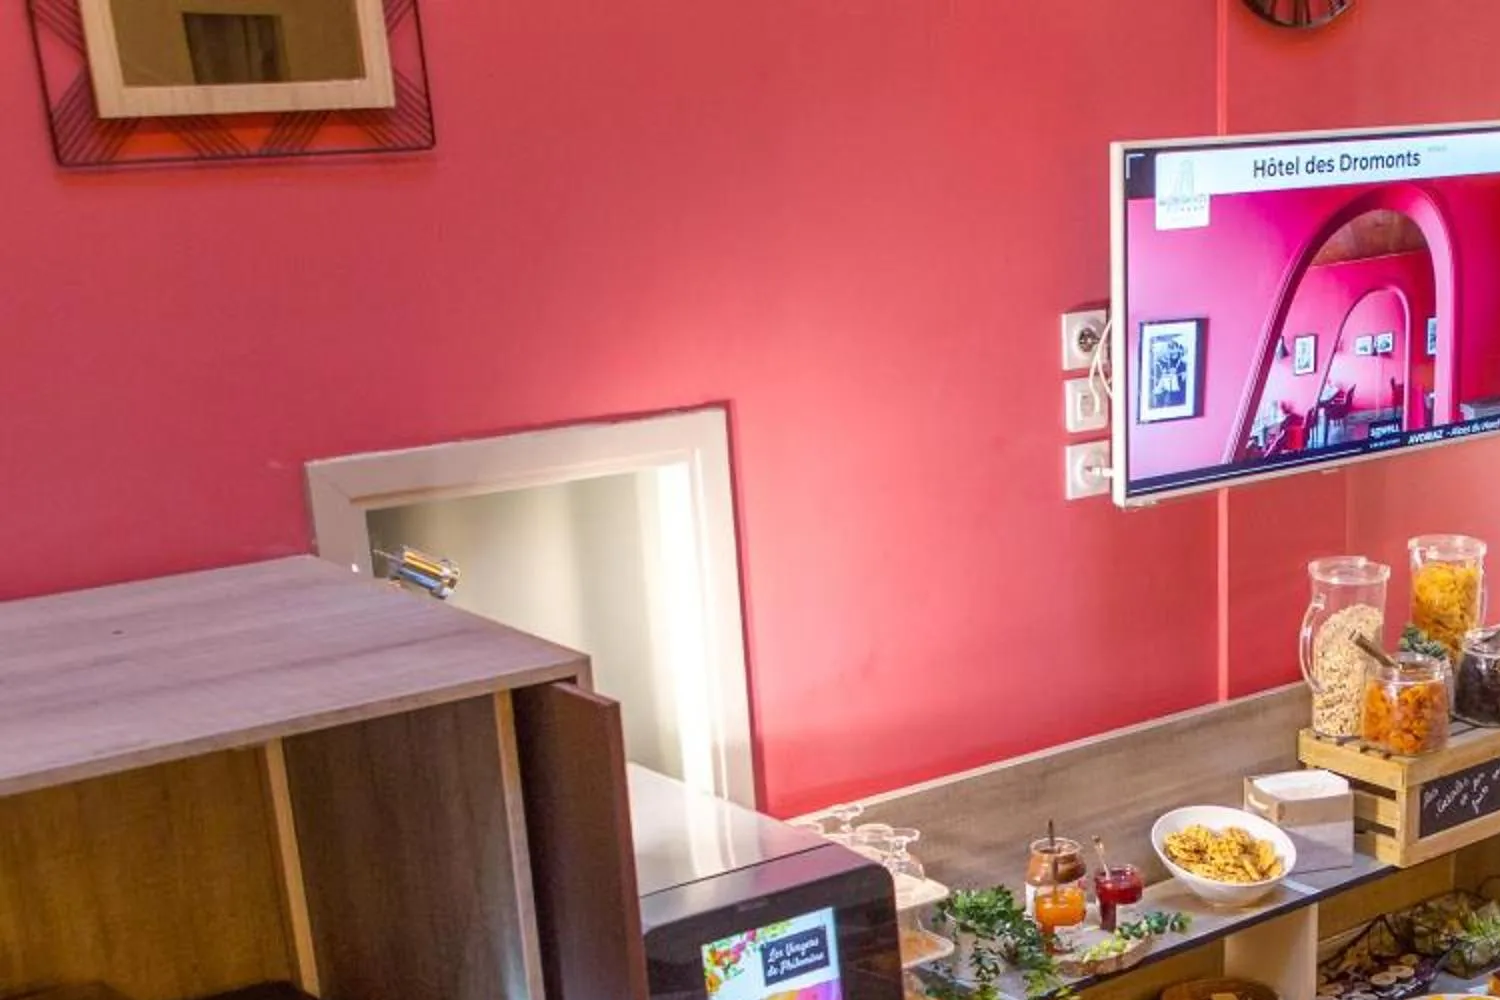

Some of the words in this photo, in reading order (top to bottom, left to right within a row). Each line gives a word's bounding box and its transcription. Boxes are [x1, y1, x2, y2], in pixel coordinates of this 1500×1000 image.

[1252, 155, 1300, 179] Hôtel
[1305, 155, 1336, 175] des
[1339, 150, 1422, 172] Dromonts
